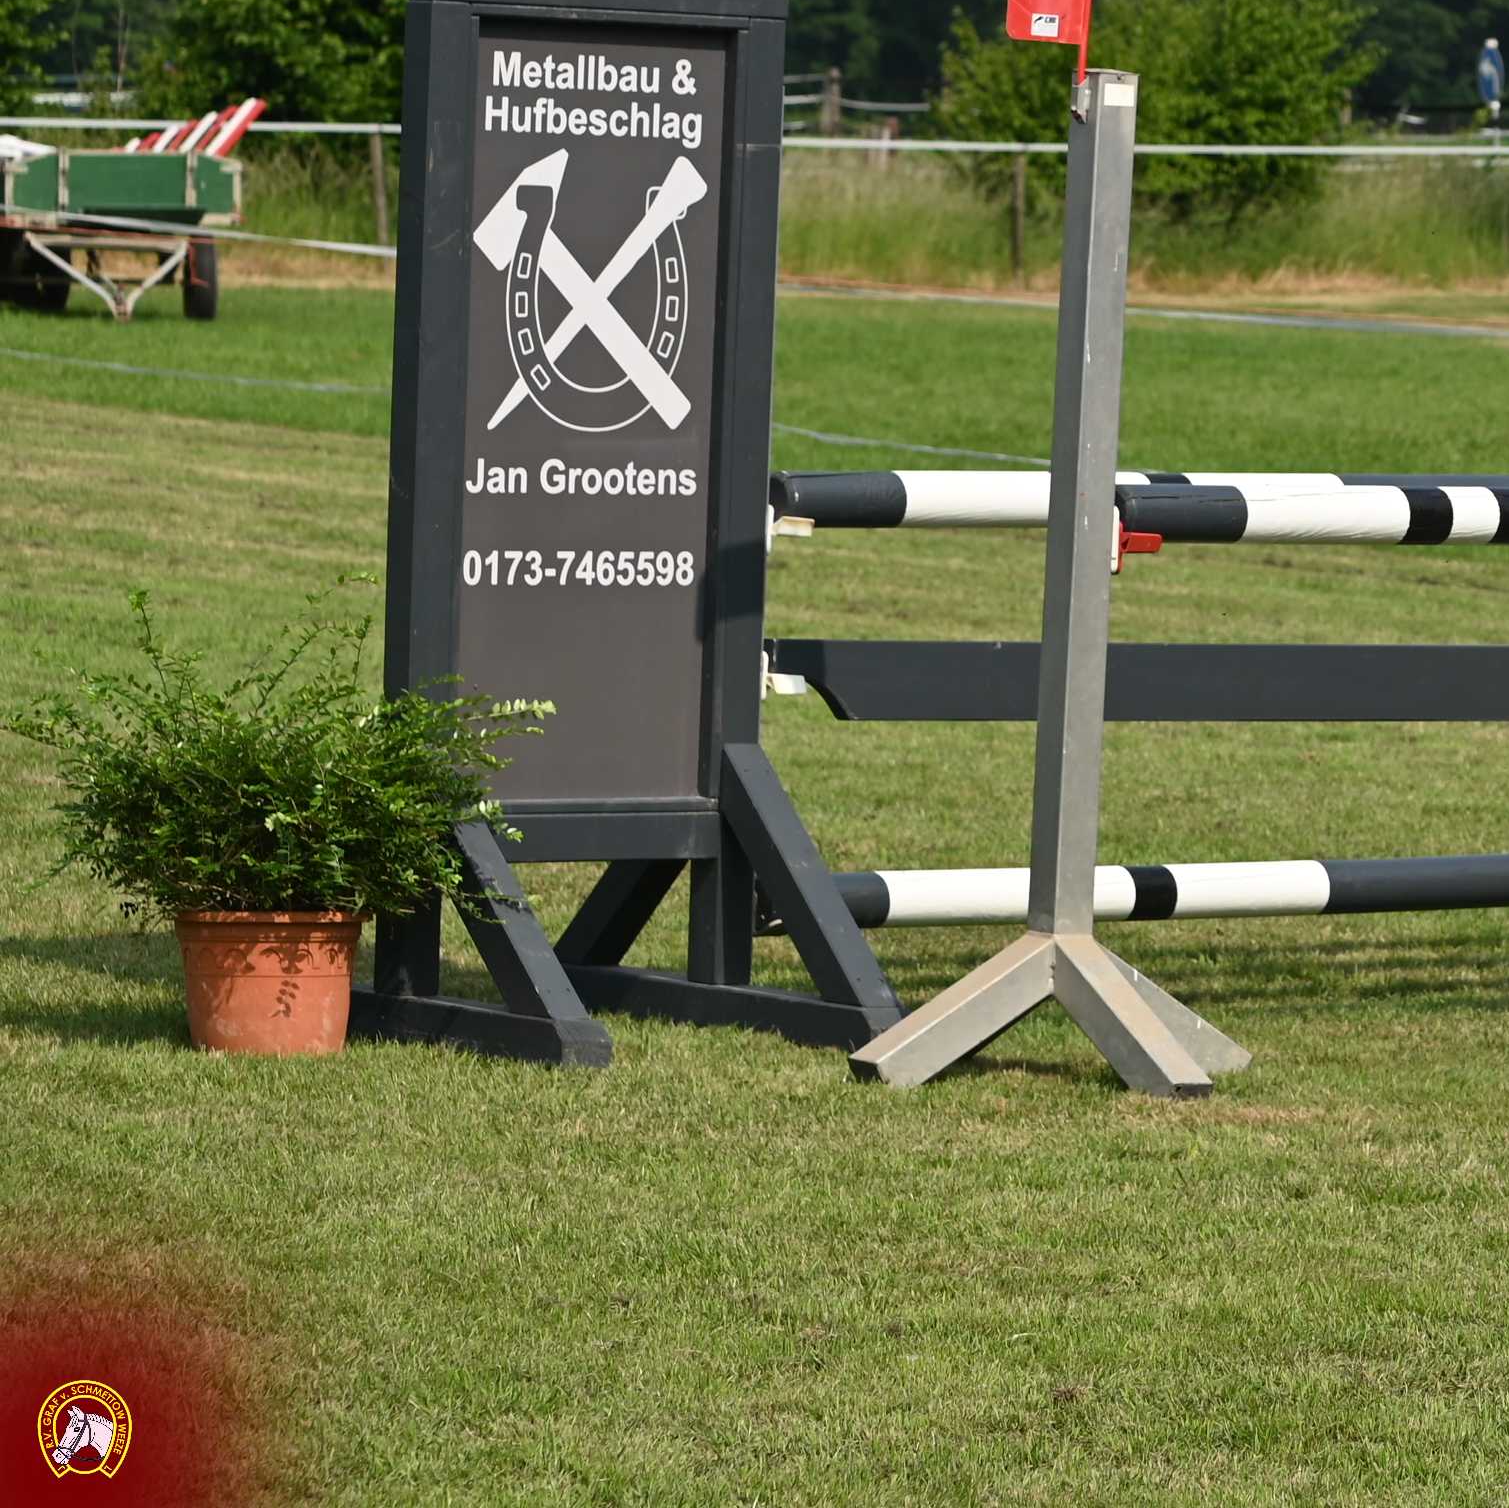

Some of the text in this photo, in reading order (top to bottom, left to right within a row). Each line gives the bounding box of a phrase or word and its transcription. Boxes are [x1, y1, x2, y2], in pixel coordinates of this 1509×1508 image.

[492, 51, 697, 96] Metallbau &
[484, 96, 703, 148] Hufbeschlag
[465, 457, 697, 496] Jan Grootens
[462, 549, 695, 587] 0173-7465598
